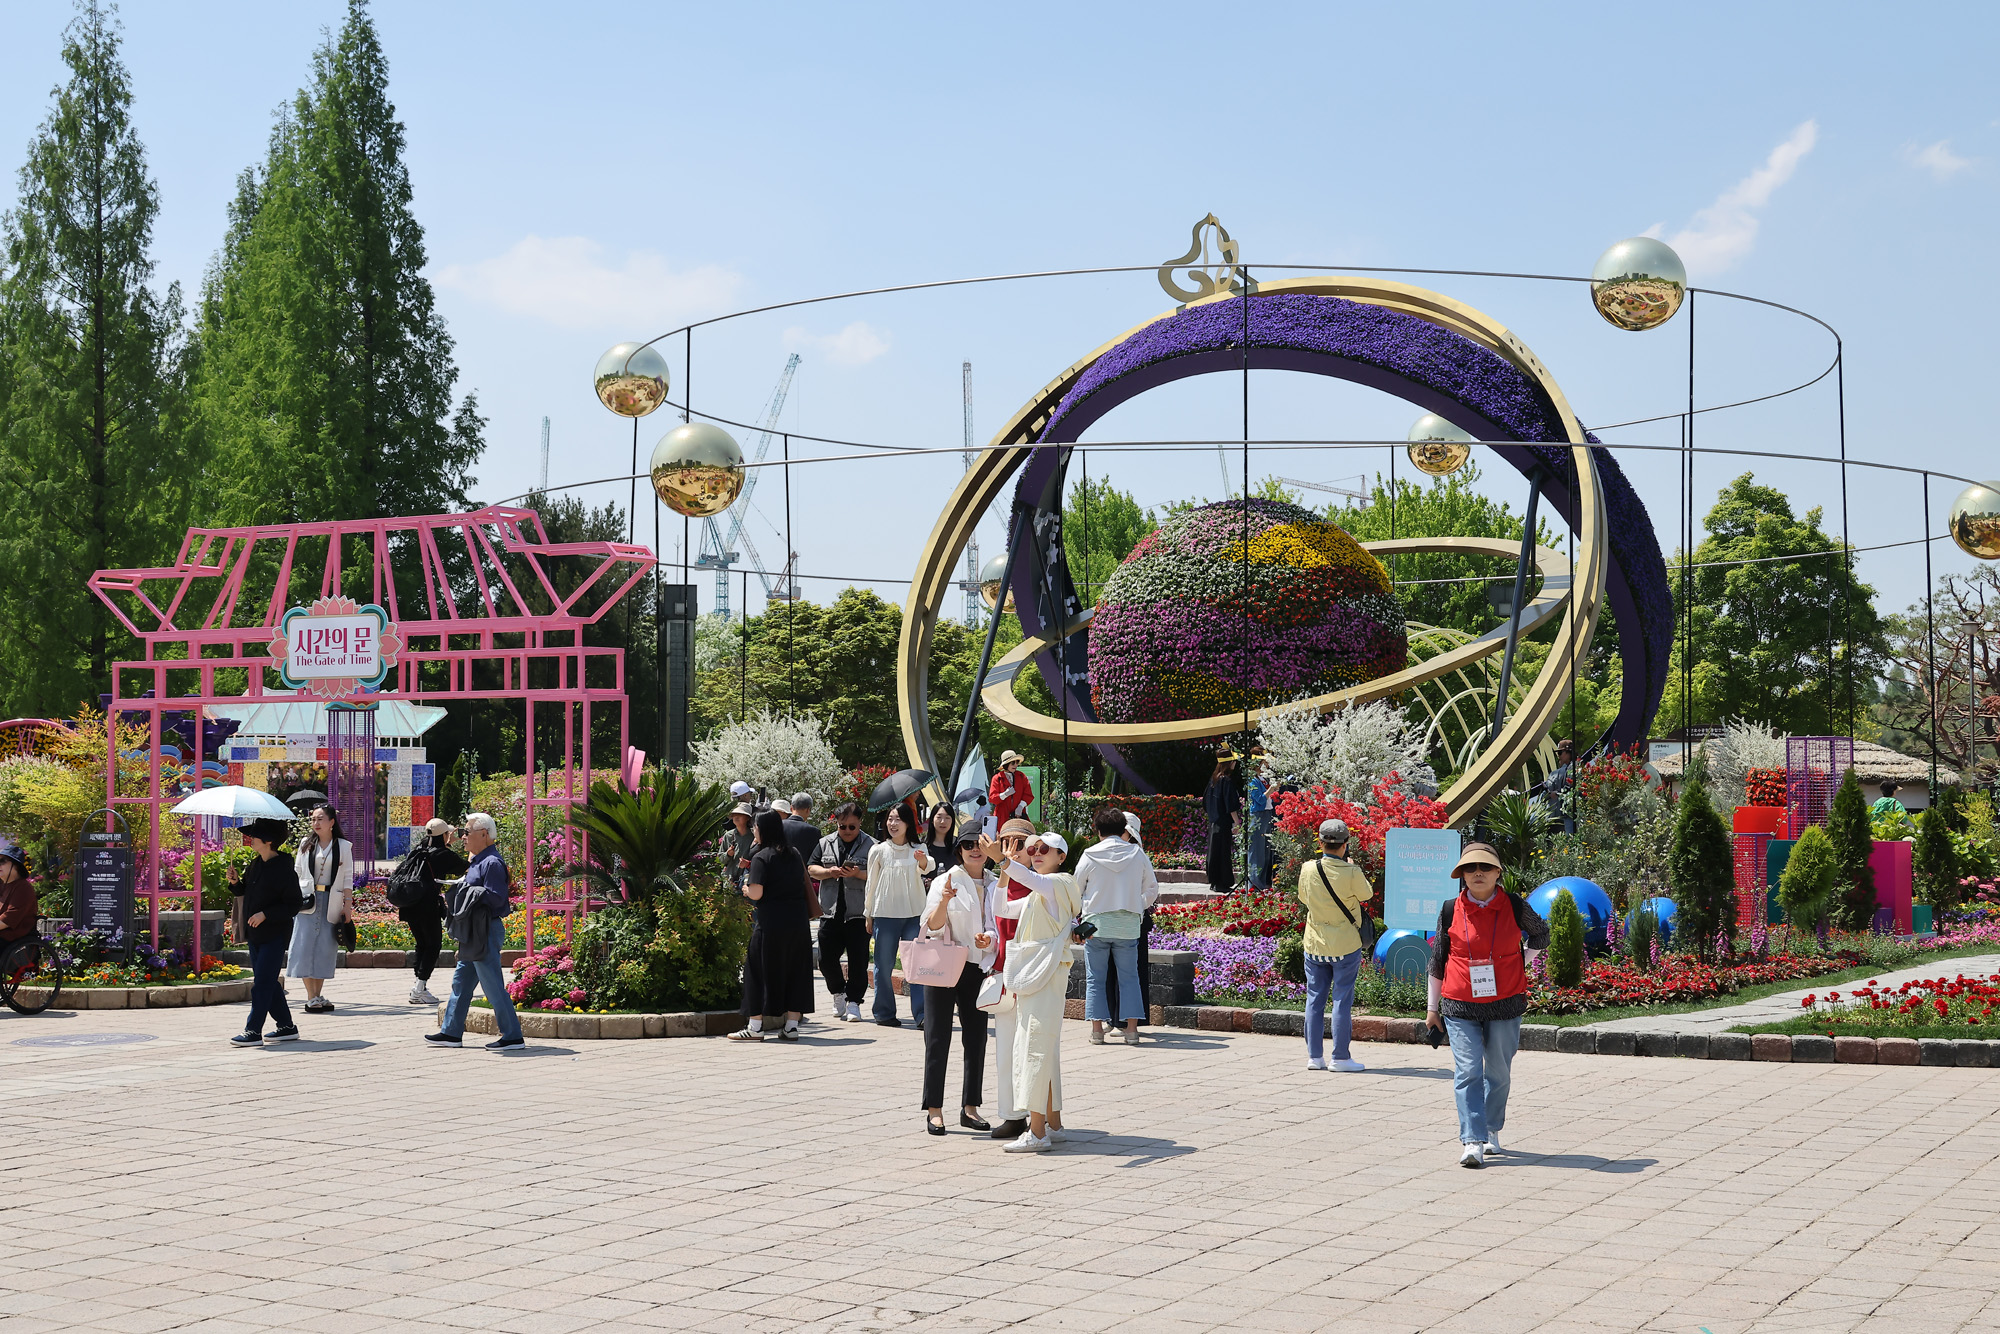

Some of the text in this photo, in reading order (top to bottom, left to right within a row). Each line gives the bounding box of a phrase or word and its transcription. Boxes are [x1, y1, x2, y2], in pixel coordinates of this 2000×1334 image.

[295, 627, 371, 655] 시간의 문
[295, 653, 372, 666] The Gate of Time
